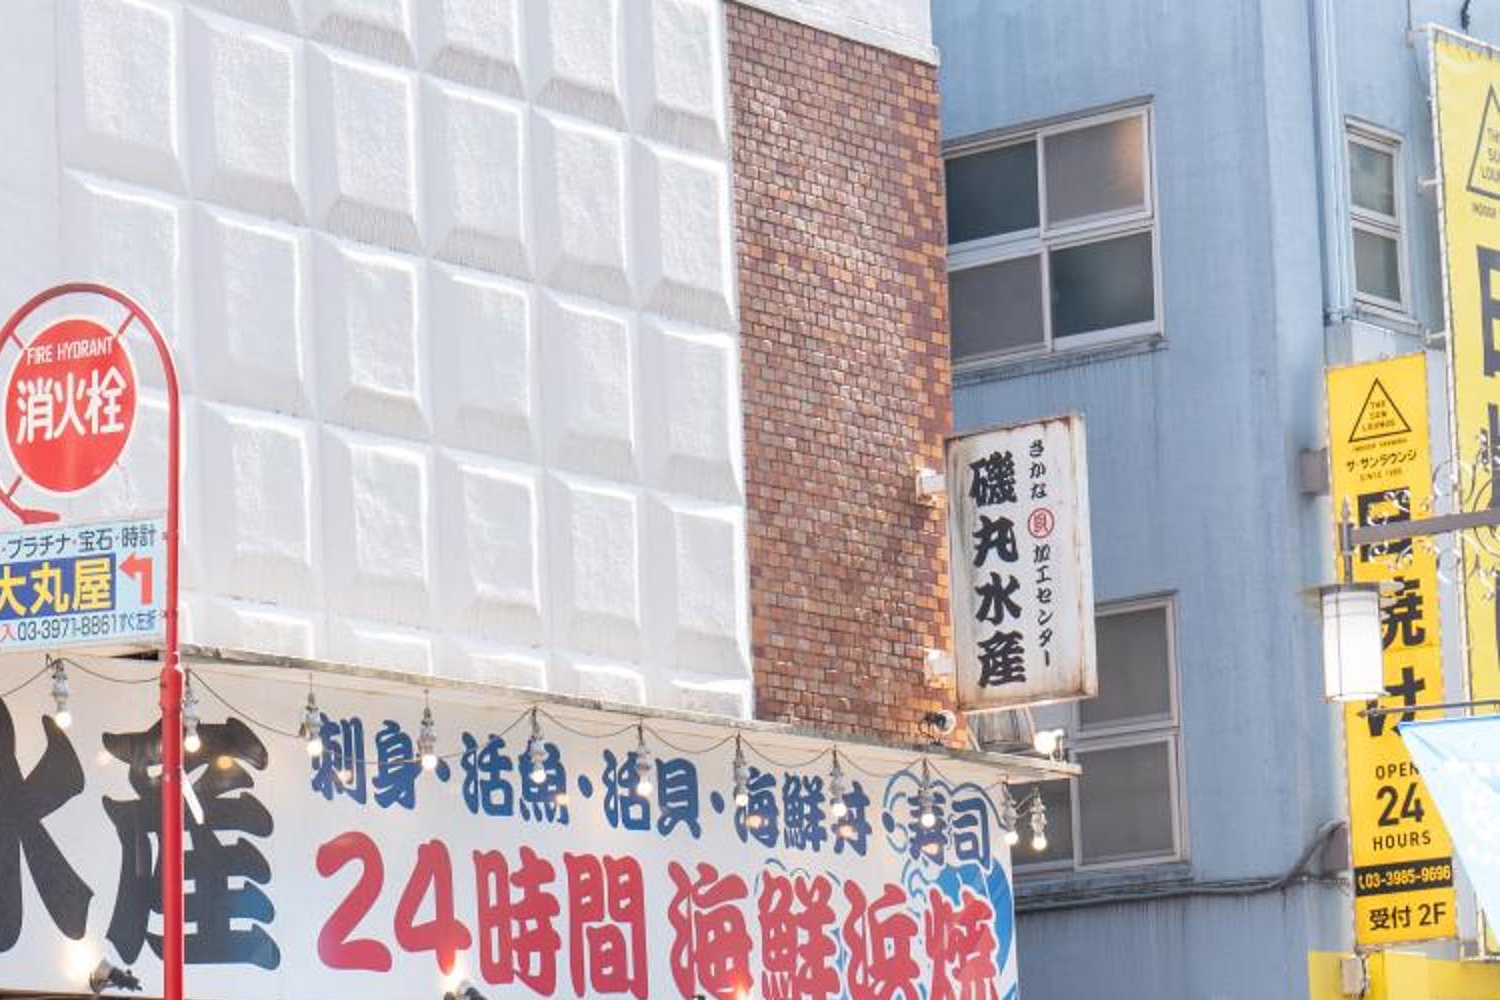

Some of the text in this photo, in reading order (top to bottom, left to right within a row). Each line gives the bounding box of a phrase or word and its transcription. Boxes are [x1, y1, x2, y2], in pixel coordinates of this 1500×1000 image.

[26, 335, 114, 364] FIRE HYDRANT
[15, 365, 127, 445] 消火栓
[968, 450, 1027, 689] 磯丸水産
[1376, 782, 1426, 828] 24
[1372, 829, 1432, 851] HOURS
[1369, 901, 1448, 931] 受付 2F
